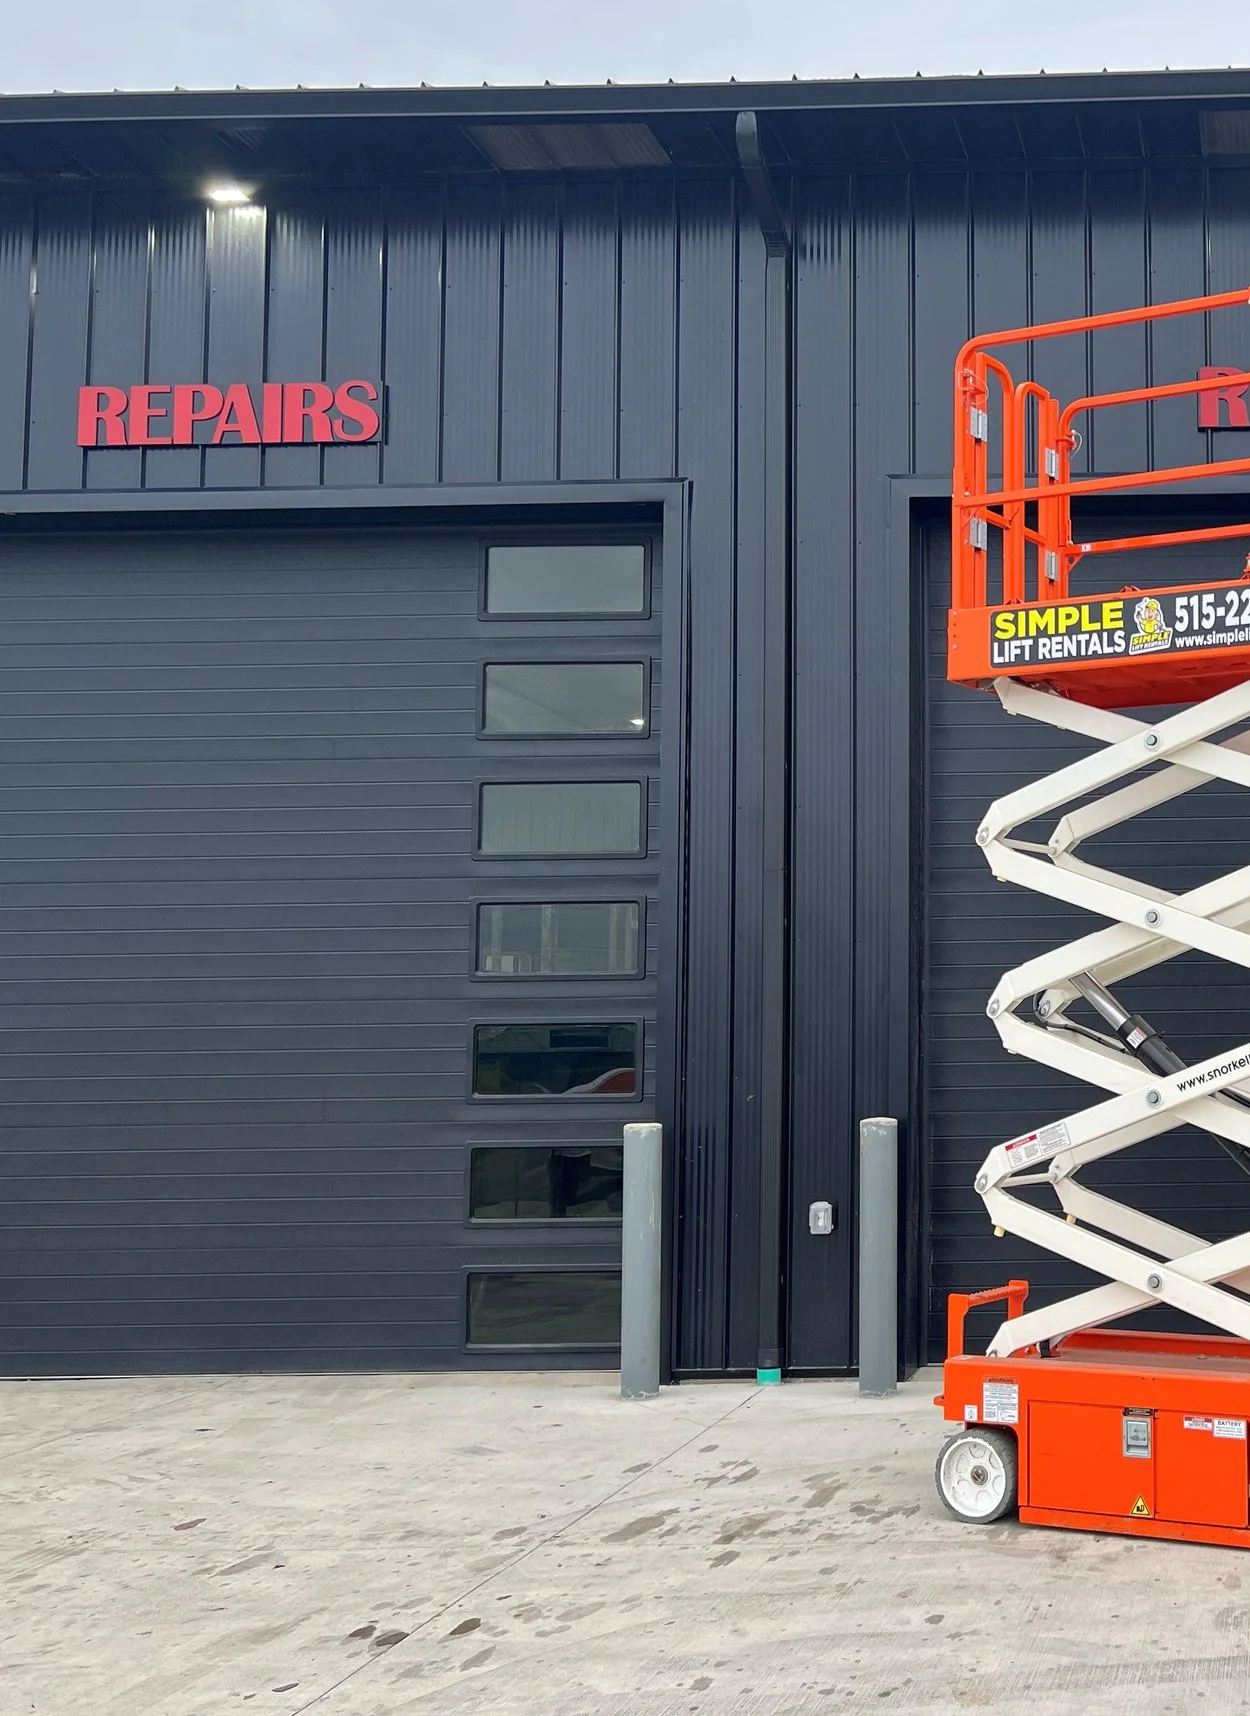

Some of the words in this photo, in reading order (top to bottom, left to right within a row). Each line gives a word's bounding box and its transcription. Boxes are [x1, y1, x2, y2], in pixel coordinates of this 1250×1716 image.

[77, 380, 380, 447] REPAIRS
[994, 601, 1124, 640] SIMPLE
[1132, 631, 1169, 645] SIMPLE
[993, 639, 1034, 664] LIFT
[1038, 630, 1126, 660] RENTALS
